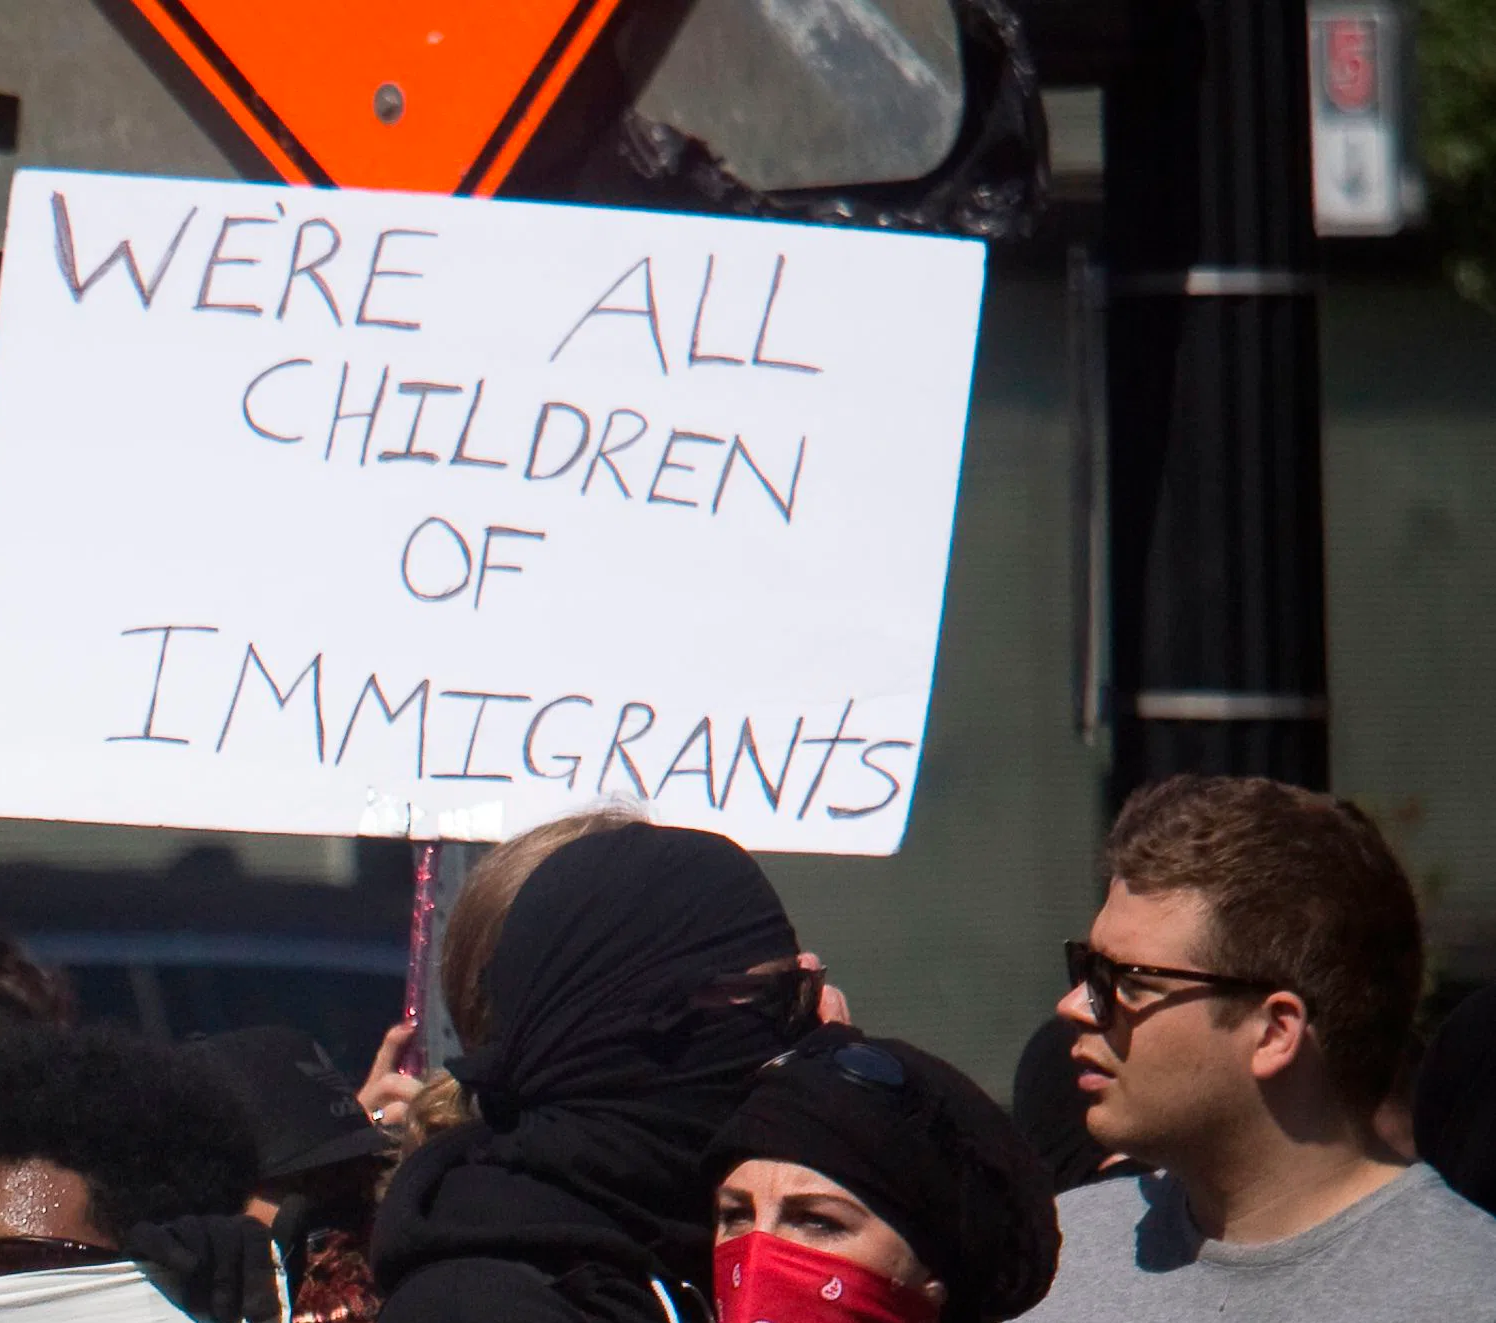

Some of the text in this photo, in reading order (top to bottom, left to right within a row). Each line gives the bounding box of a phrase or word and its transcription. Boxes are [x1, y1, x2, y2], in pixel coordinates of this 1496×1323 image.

[549, 252, 823, 375] ALL
[242, 357, 807, 524] CHILDREN
[400, 516, 547, 611] OF
